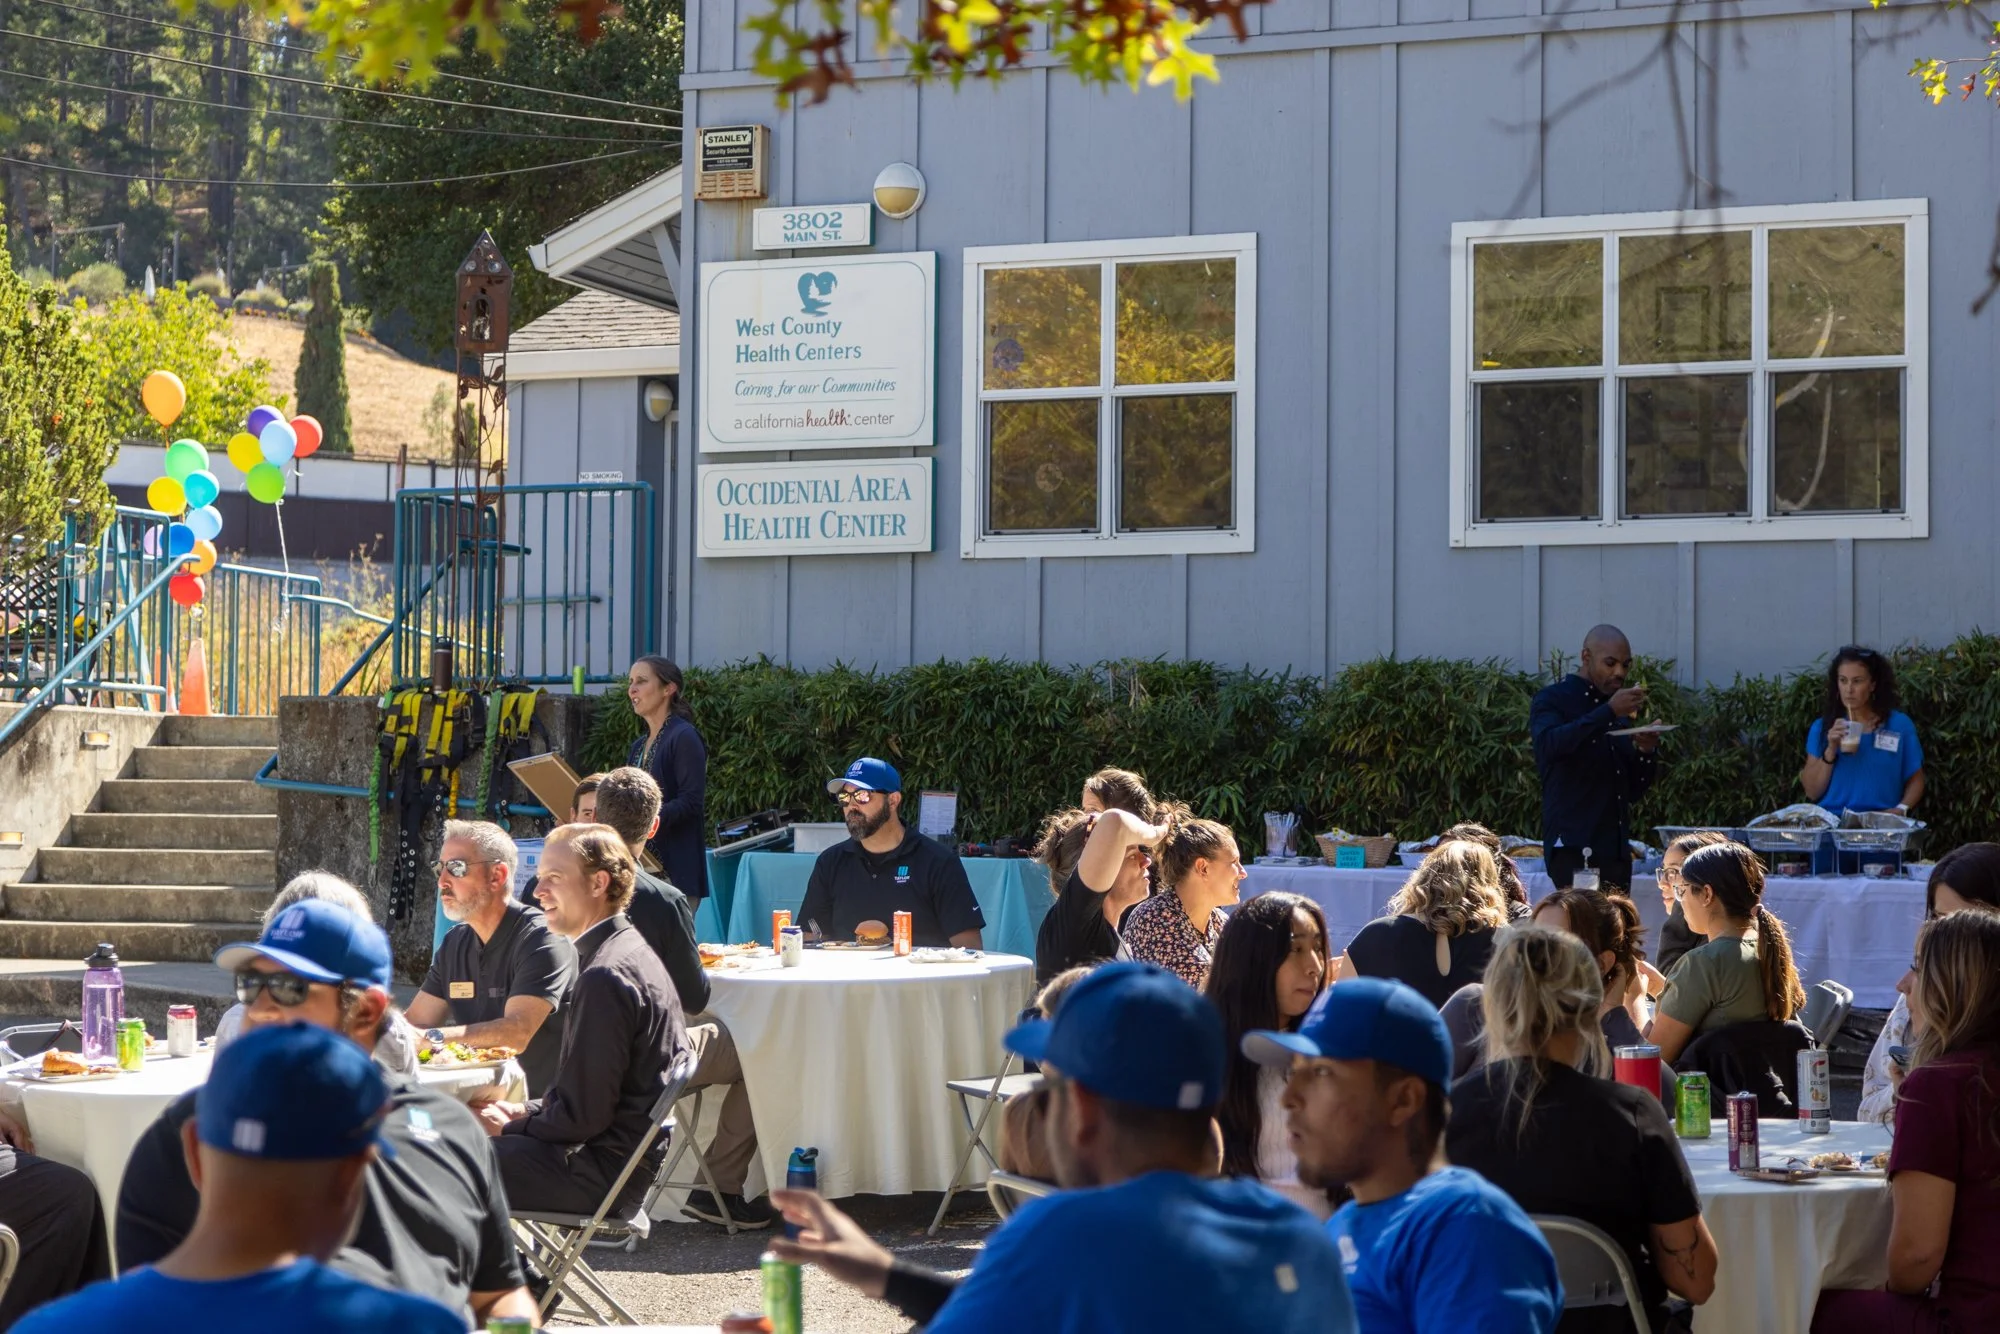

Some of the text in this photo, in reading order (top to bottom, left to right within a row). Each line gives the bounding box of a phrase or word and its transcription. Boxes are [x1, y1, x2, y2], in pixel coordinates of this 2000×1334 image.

[708, 134, 748, 144] STANLEY
[706, 147, 750, 156] Security Solutions
[782, 211, 843, 231] 3802
[783, 230, 843, 243] MAIN ST.
[736, 316, 842, 338] West County
[735, 342, 862, 364] Health Centers
[734, 376, 896, 398] Caring for our Communities
[734, 419, 743, 430] a
[745, 412, 804, 429] california
[854, 413, 896, 426] center
[716, 473, 912, 507] OCCIDENTAL AREA
[723, 509, 907, 542] HEALTH CENTER
